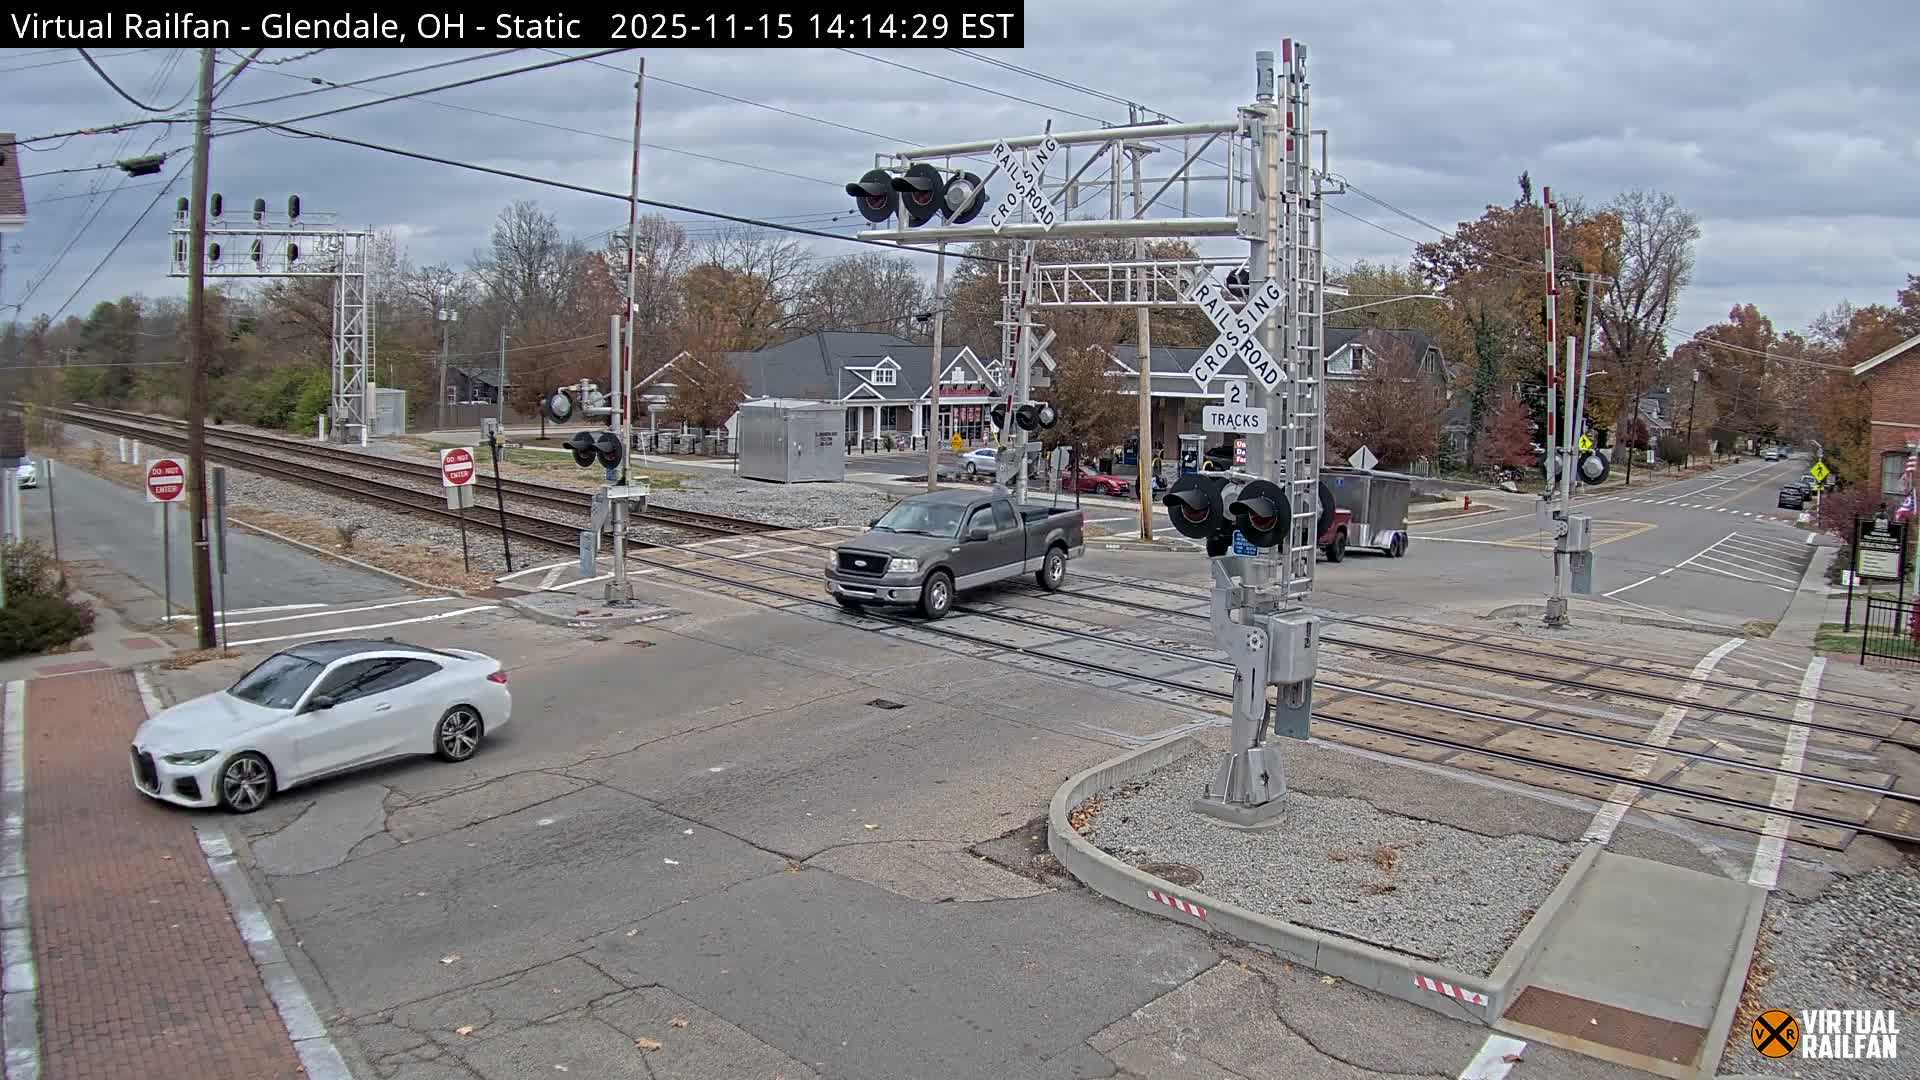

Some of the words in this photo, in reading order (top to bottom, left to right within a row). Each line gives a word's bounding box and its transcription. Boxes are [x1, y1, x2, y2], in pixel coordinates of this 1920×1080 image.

[991, 139, 1056, 227] CROSSING
[1195, 284, 1280, 382] CROSSING
[1211, 413, 1260, 428] TRACKS
[1230, 386, 1241, 403] 2
